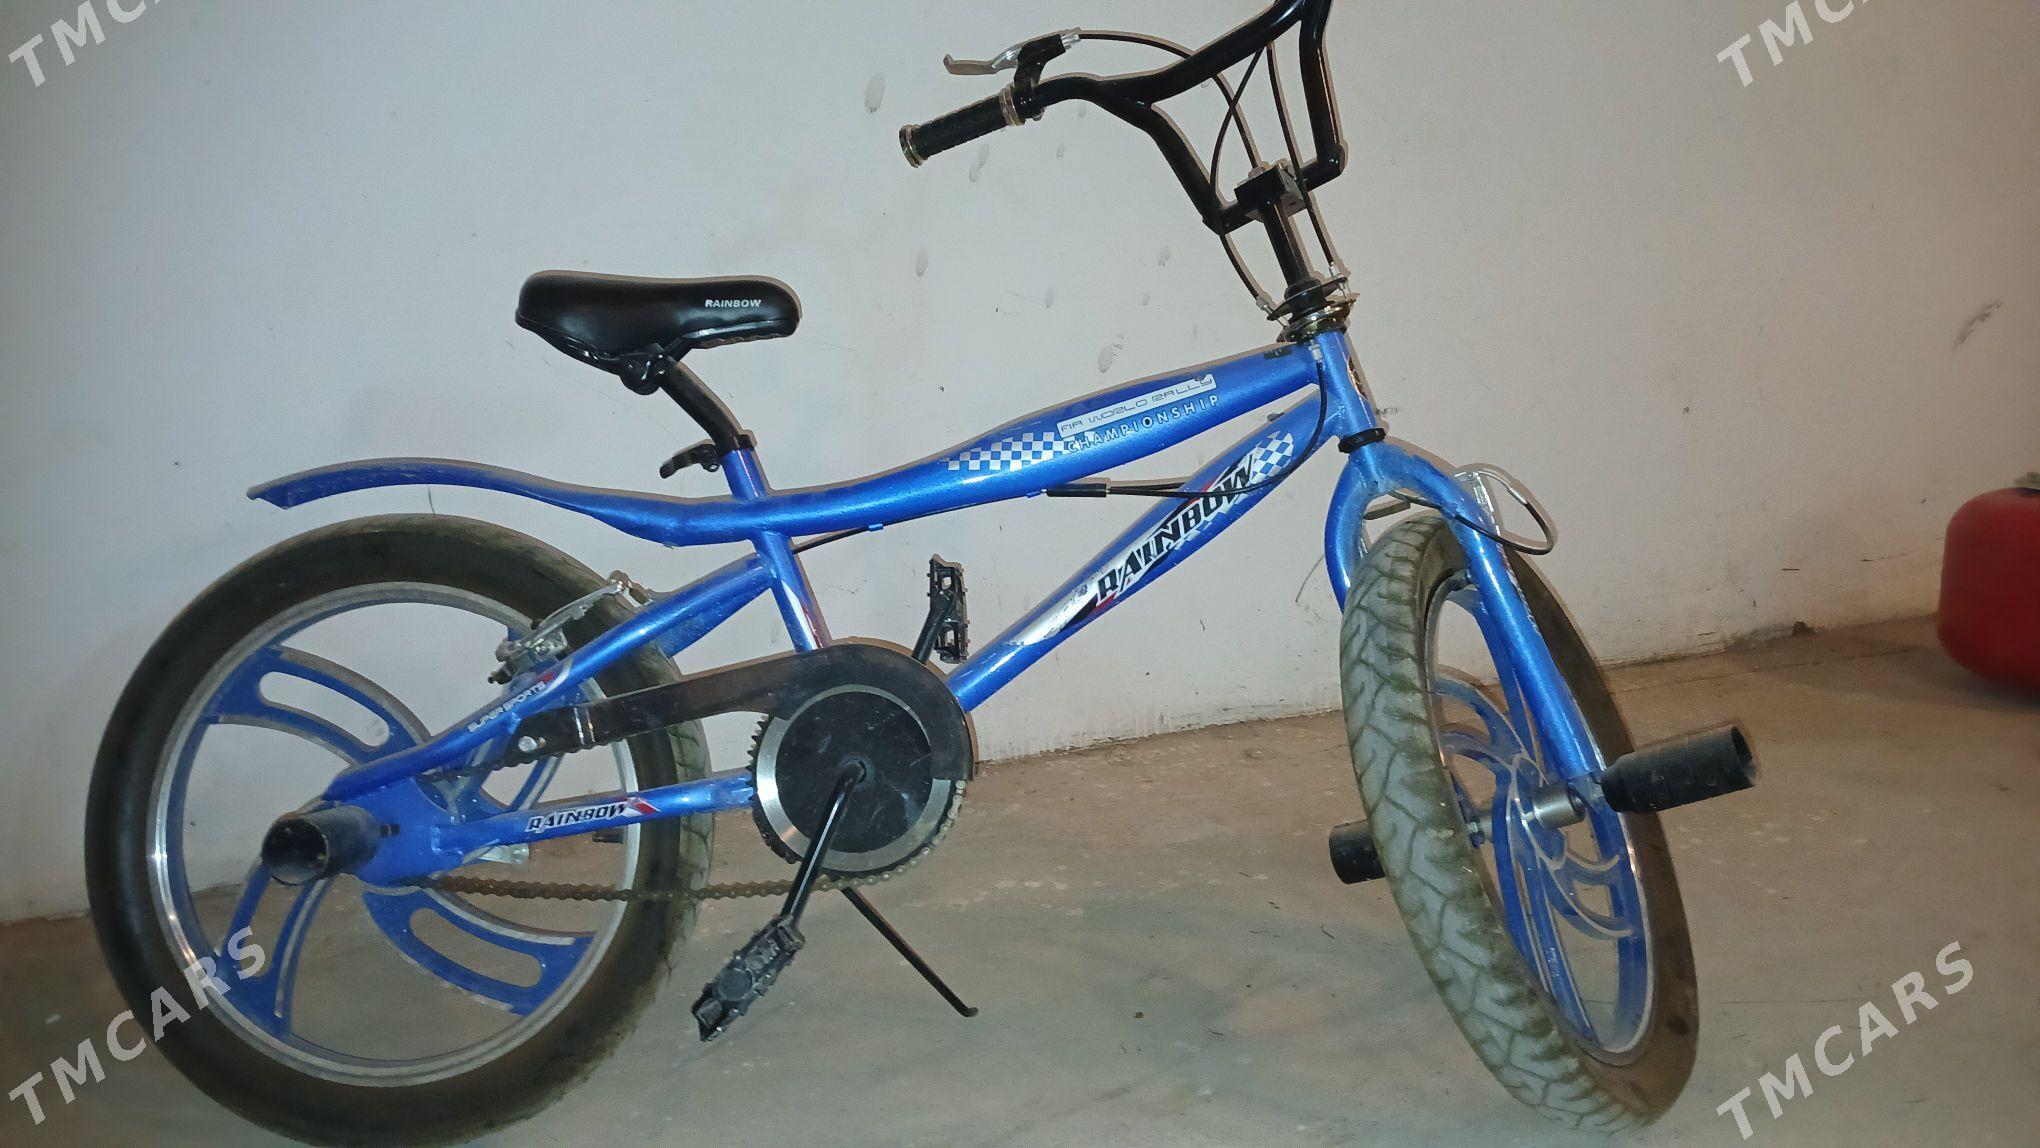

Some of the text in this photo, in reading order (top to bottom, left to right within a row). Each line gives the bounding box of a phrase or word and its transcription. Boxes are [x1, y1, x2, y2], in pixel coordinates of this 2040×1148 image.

[704, 299, 761, 308] RAINBOW
[1060, 377, 1213, 433] FIA WORLD RALLY
[1067, 394, 1219, 453] CHAMPIONSHIP
[1097, 453, 1253, 598] RAINBOW
[503, 681, 546, 711] SPORTS
[527, 801, 627, 832] RAINBOW
